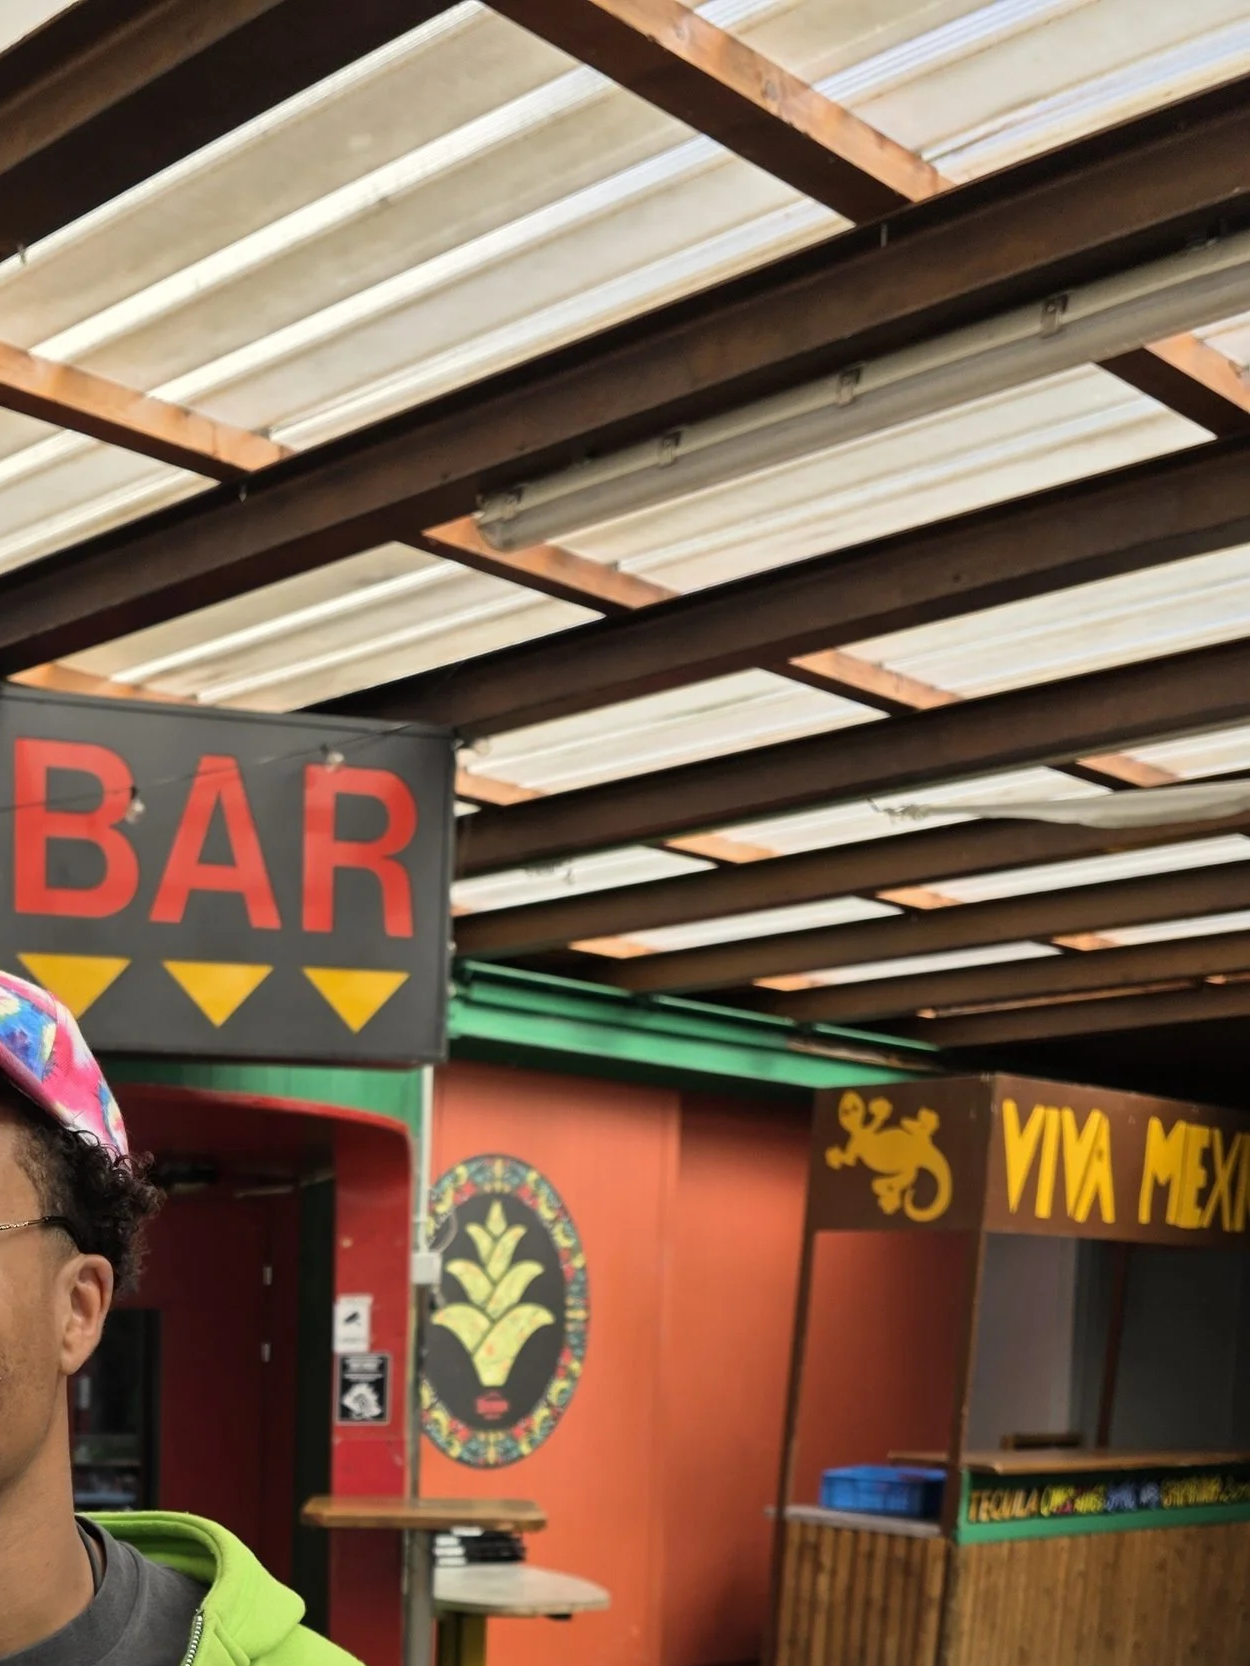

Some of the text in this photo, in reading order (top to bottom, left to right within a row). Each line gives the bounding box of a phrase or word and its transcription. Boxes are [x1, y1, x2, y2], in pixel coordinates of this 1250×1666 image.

[13, 737, 418, 938] BAR
[1002, 1098, 1250, 1233] VIVA MEXI
